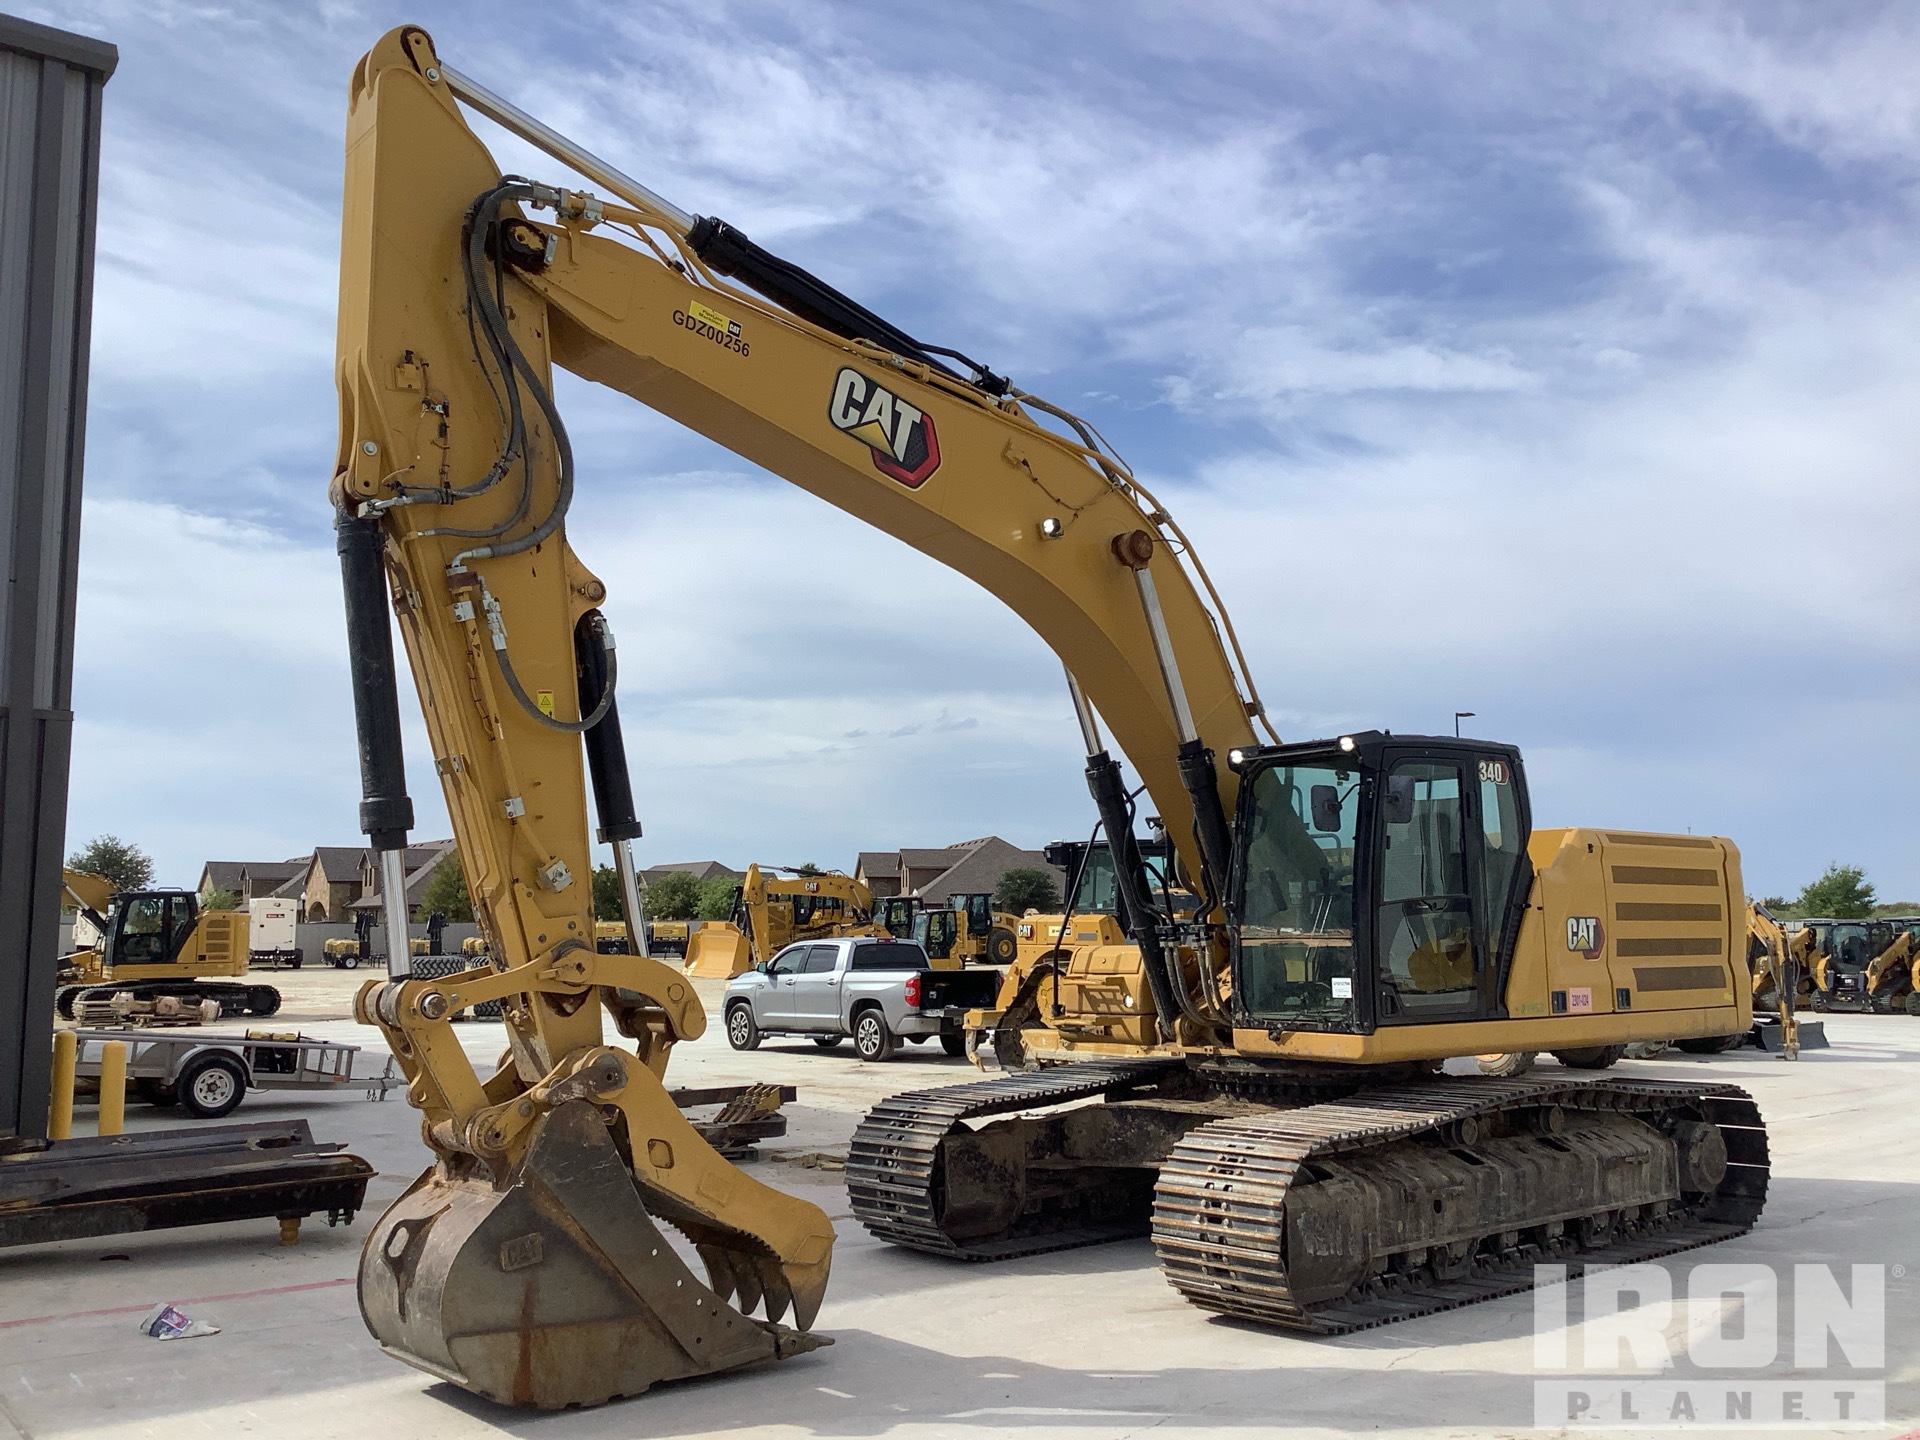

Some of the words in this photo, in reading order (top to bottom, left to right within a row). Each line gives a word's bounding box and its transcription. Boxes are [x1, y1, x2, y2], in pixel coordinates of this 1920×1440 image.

[672, 309, 750, 357] GDZ00256
[830, 368, 923, 463] CAT
[1479, 761, 1502, 783] 340
[804, 881, 818, 892] CAT
[1018, 924, 1032, 938] CAT
[1567, 917, 1597, 951] CAT
